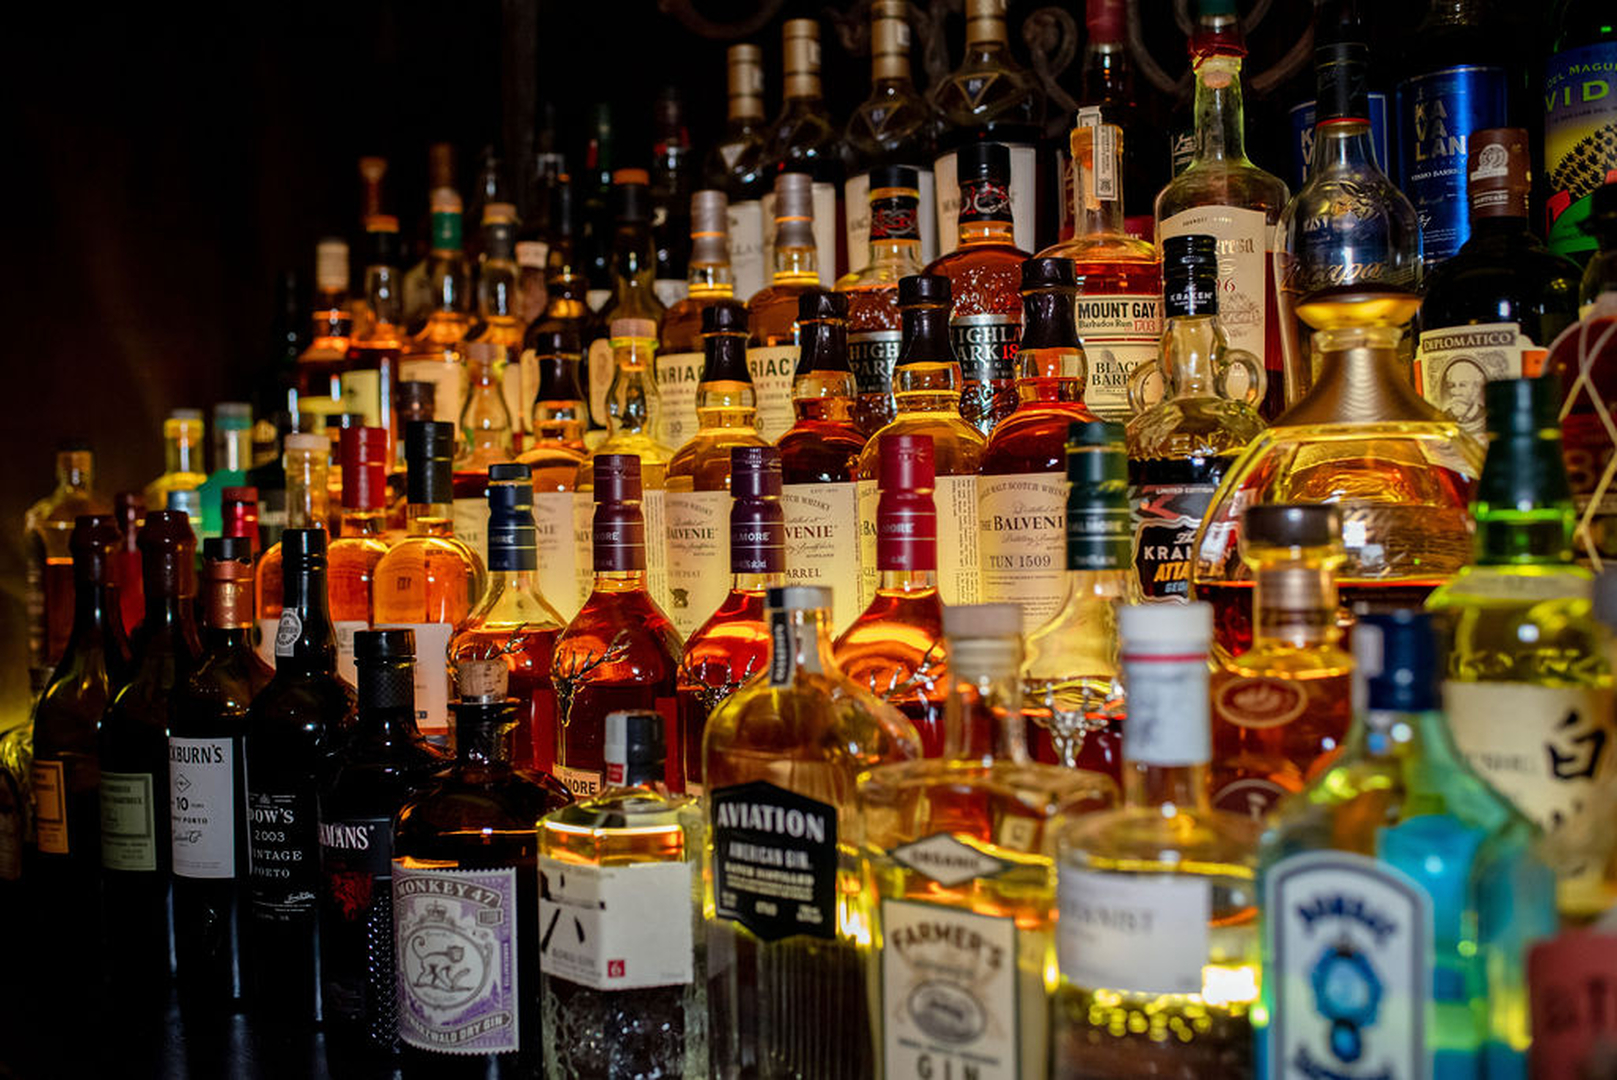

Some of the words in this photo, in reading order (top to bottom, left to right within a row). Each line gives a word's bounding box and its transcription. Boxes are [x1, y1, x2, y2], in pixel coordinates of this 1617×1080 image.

[1545, 80, 1609, 113] VID
[1078, 302, 1129, 319] MOUNT
[1132, 302, 1156, 318] GAY
[1079, 319, 1114, 328] Barbados
[1115, 318, 1133, 327] Rum
[1134, 319, 1156, 332] 1703
[1095, 360, 1138, 374] BLAC
[1009, 481, 1039, 492] SCOTCH
[993, 514, 1064, 532] BALVENI
[989, 554, 1014, 569] TUN
[1018, 554, 1052, 568] 1509
[176, 797, 189, 812] 10
[717, 801, 825, 844] AVIATION
[253, 829, 286, 843] 2003
[397, 877, 469, 901] MONKEY
[470, 887, 494, 906] 47
[890, 921, 1004, 970] FARMER'S
[610, 962, 622, 978] 6
[459, 1022, 482, 1040] DRY
[482, 1013, 504, 1031] GIN
